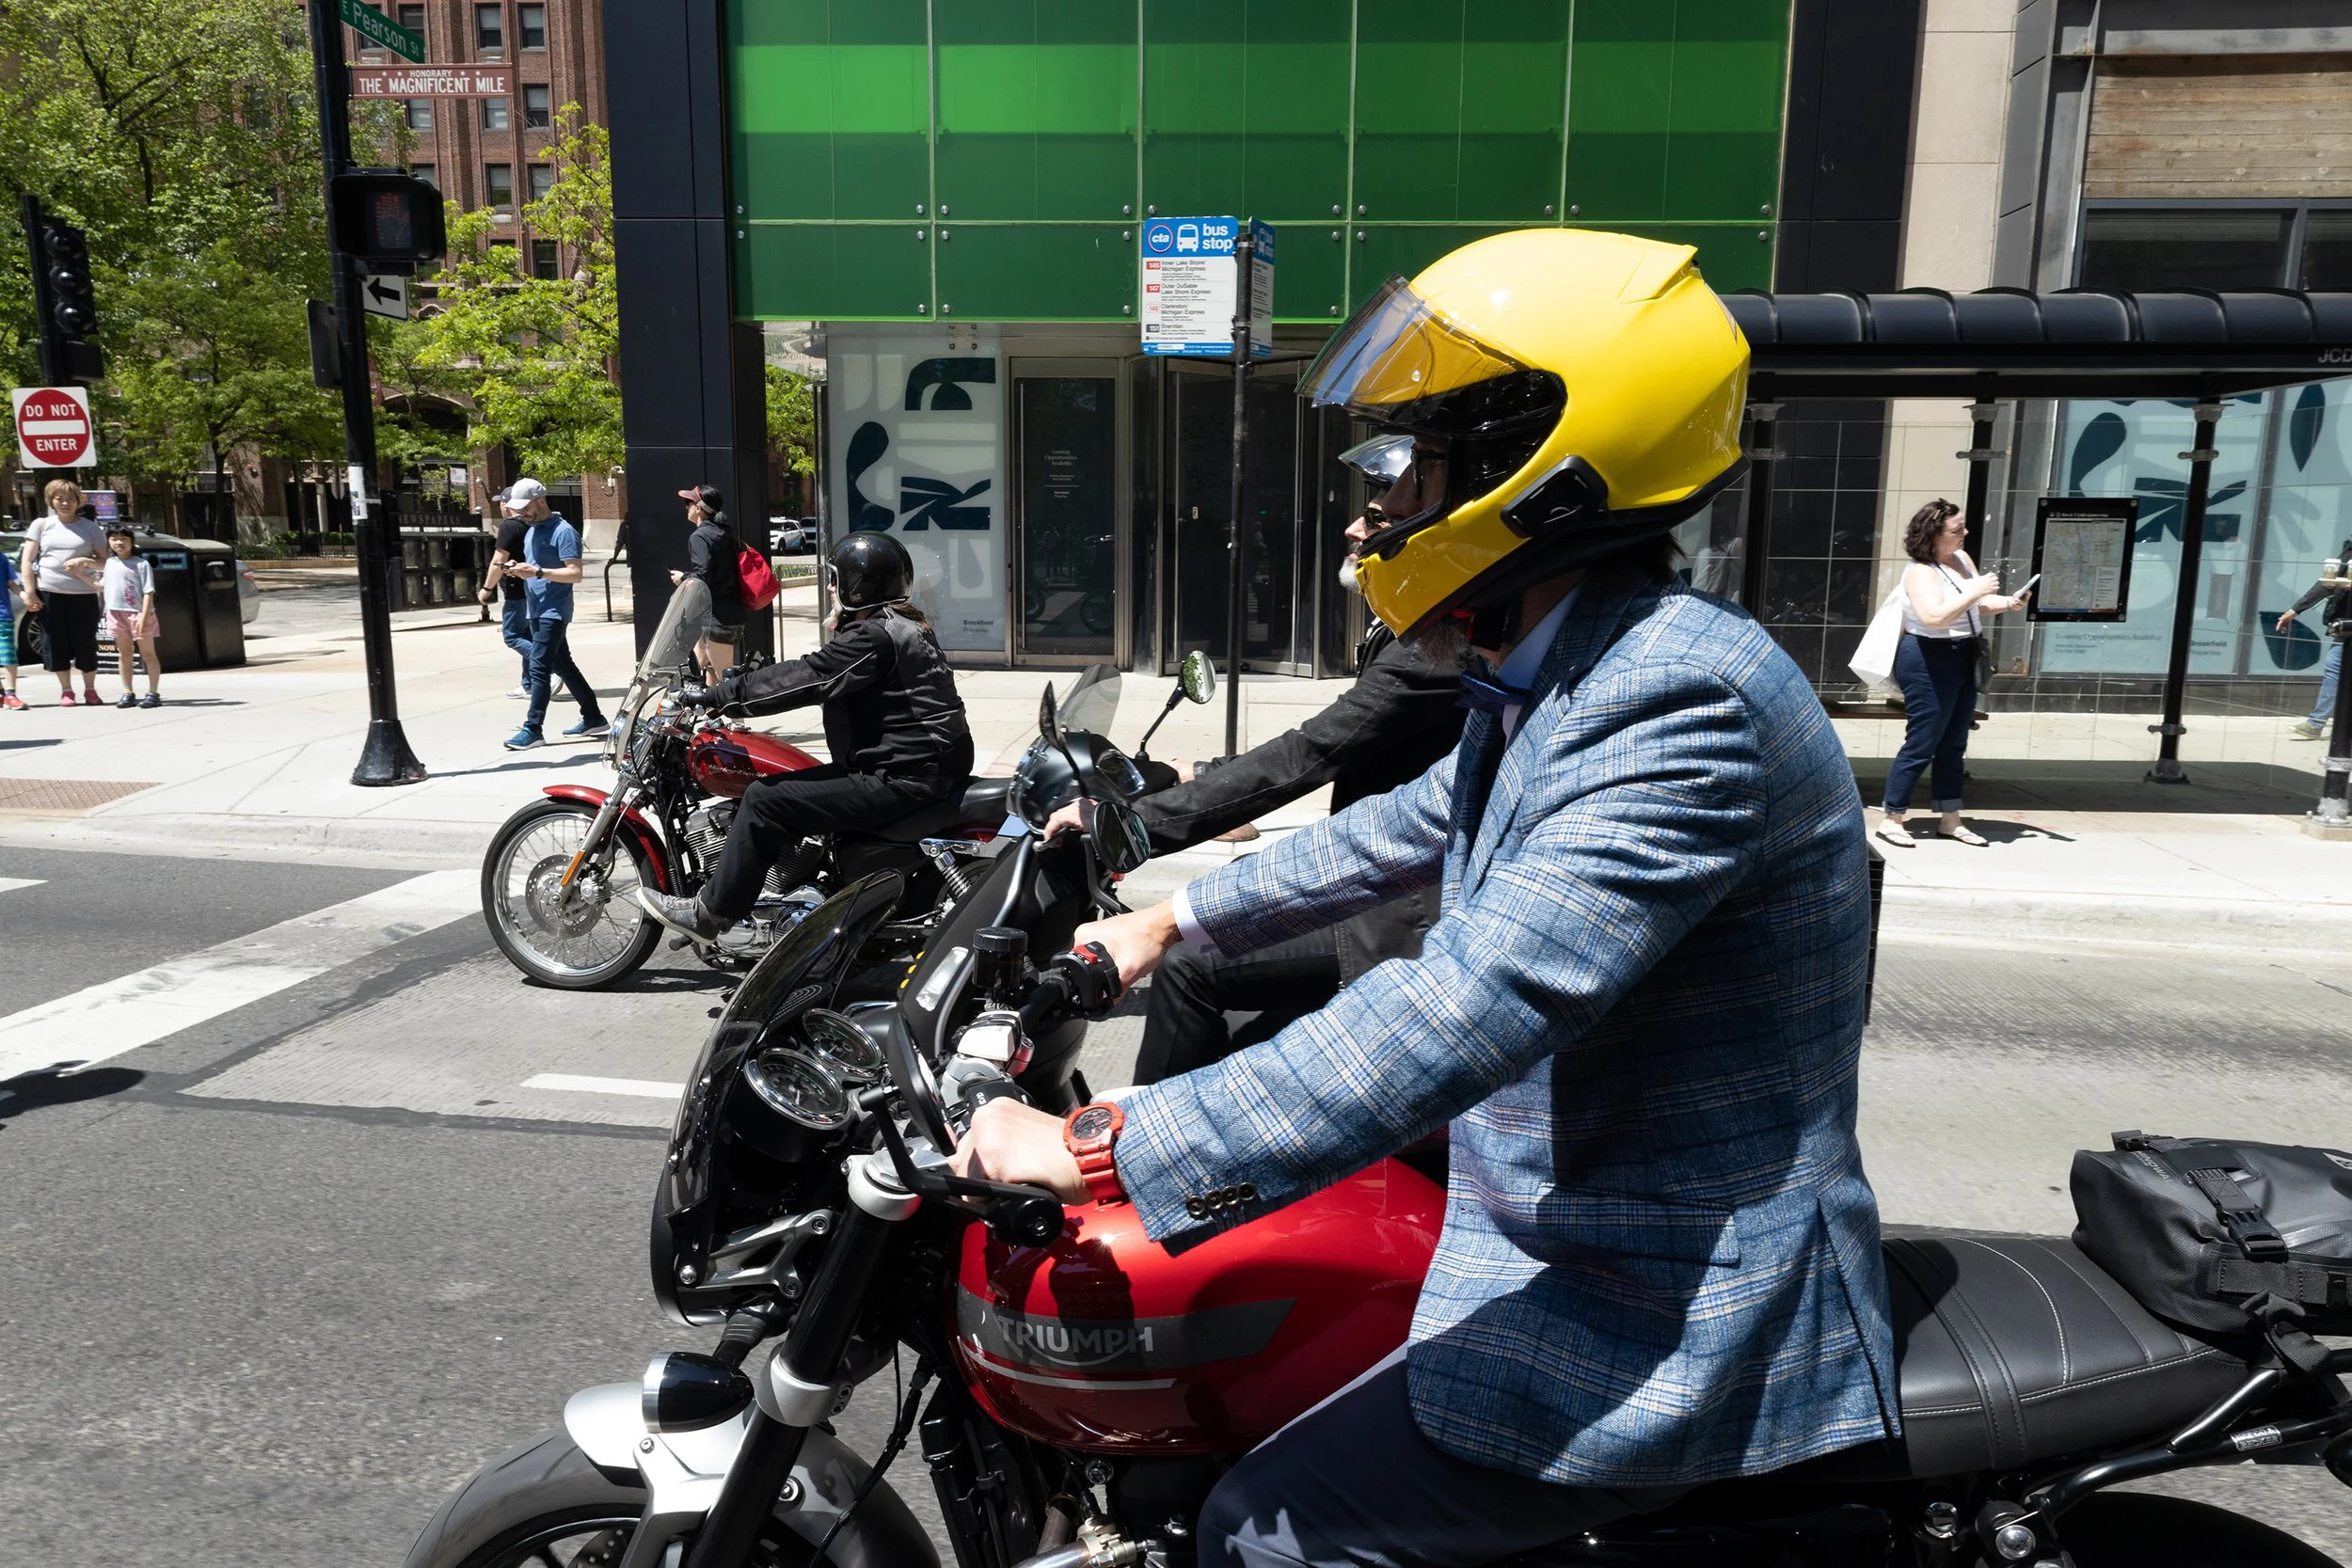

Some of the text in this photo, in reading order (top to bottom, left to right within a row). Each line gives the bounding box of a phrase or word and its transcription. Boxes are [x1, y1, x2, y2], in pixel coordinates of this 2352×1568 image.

[342, 1, 420, 56] E Pearson St
[359, 77, 505, 93] THE MAGNIFICENT MILE
[1202, 223, 1228, 236] bus
[1152, 233, 1169, 243] cta
[1202, 237, 1233, 253] stop
[25, 404, 76, 417] DO NOT
[36, 438, 77, 451] ENTER
[2084, 633, 2131, 641] Opportunities
[997, 1316, 1154, 1353] TRIUMPH
